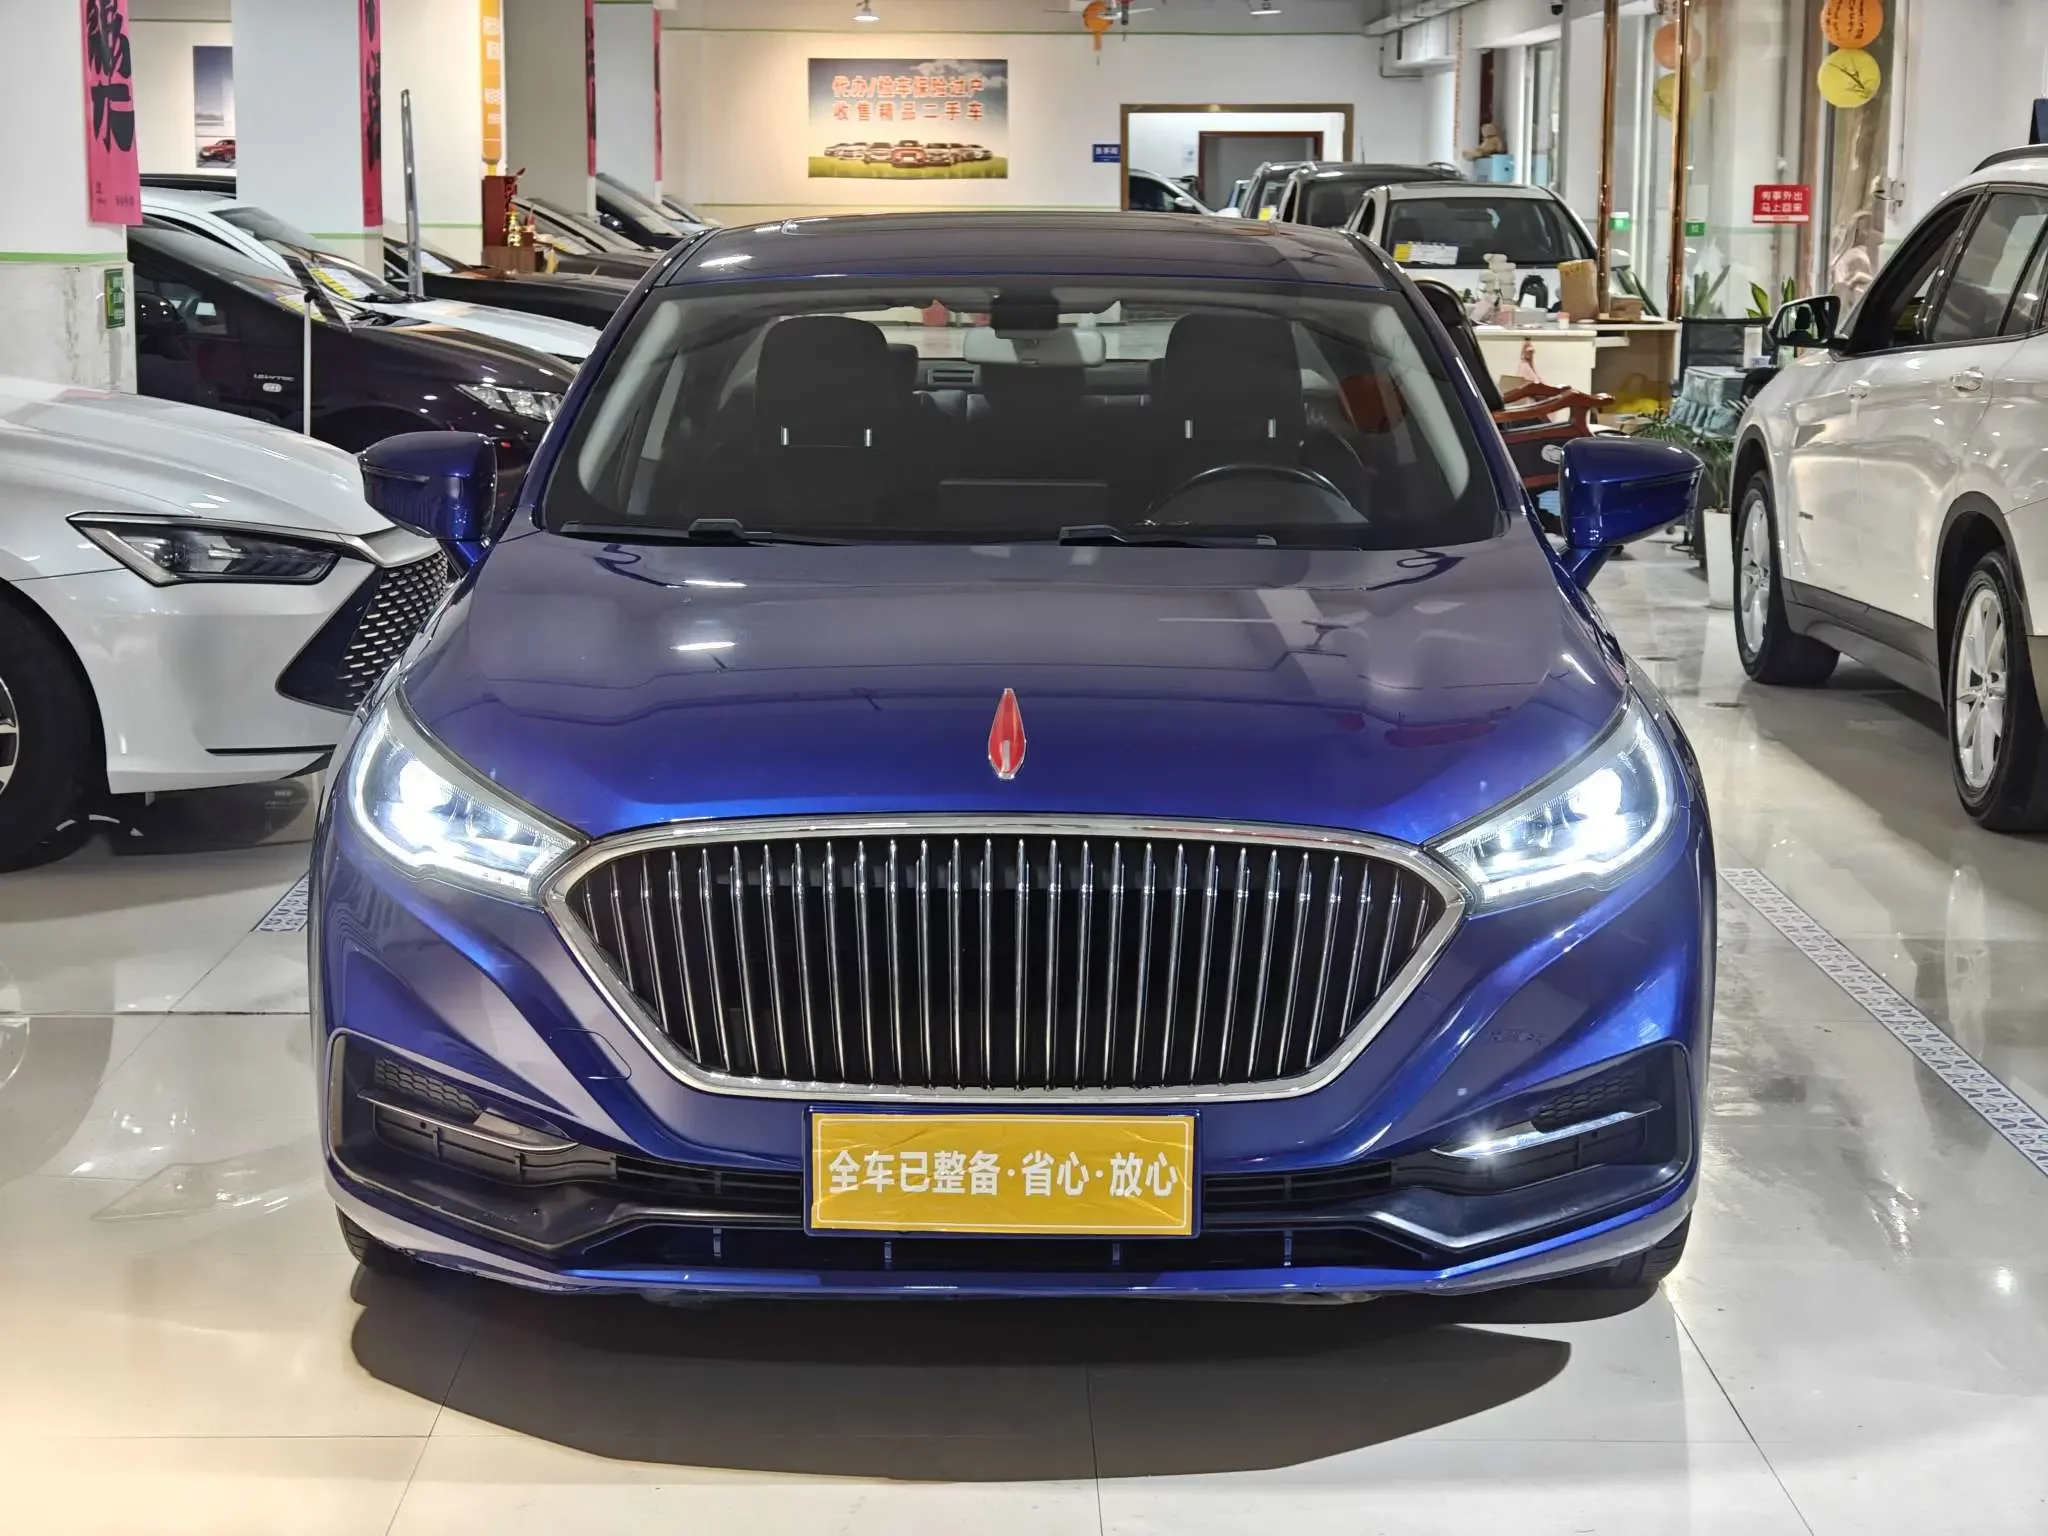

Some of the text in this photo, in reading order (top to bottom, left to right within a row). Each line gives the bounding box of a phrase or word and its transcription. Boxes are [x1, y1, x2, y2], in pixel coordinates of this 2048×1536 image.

[828, 1149, 1179, 1197] 全车已整备·省心·放心
